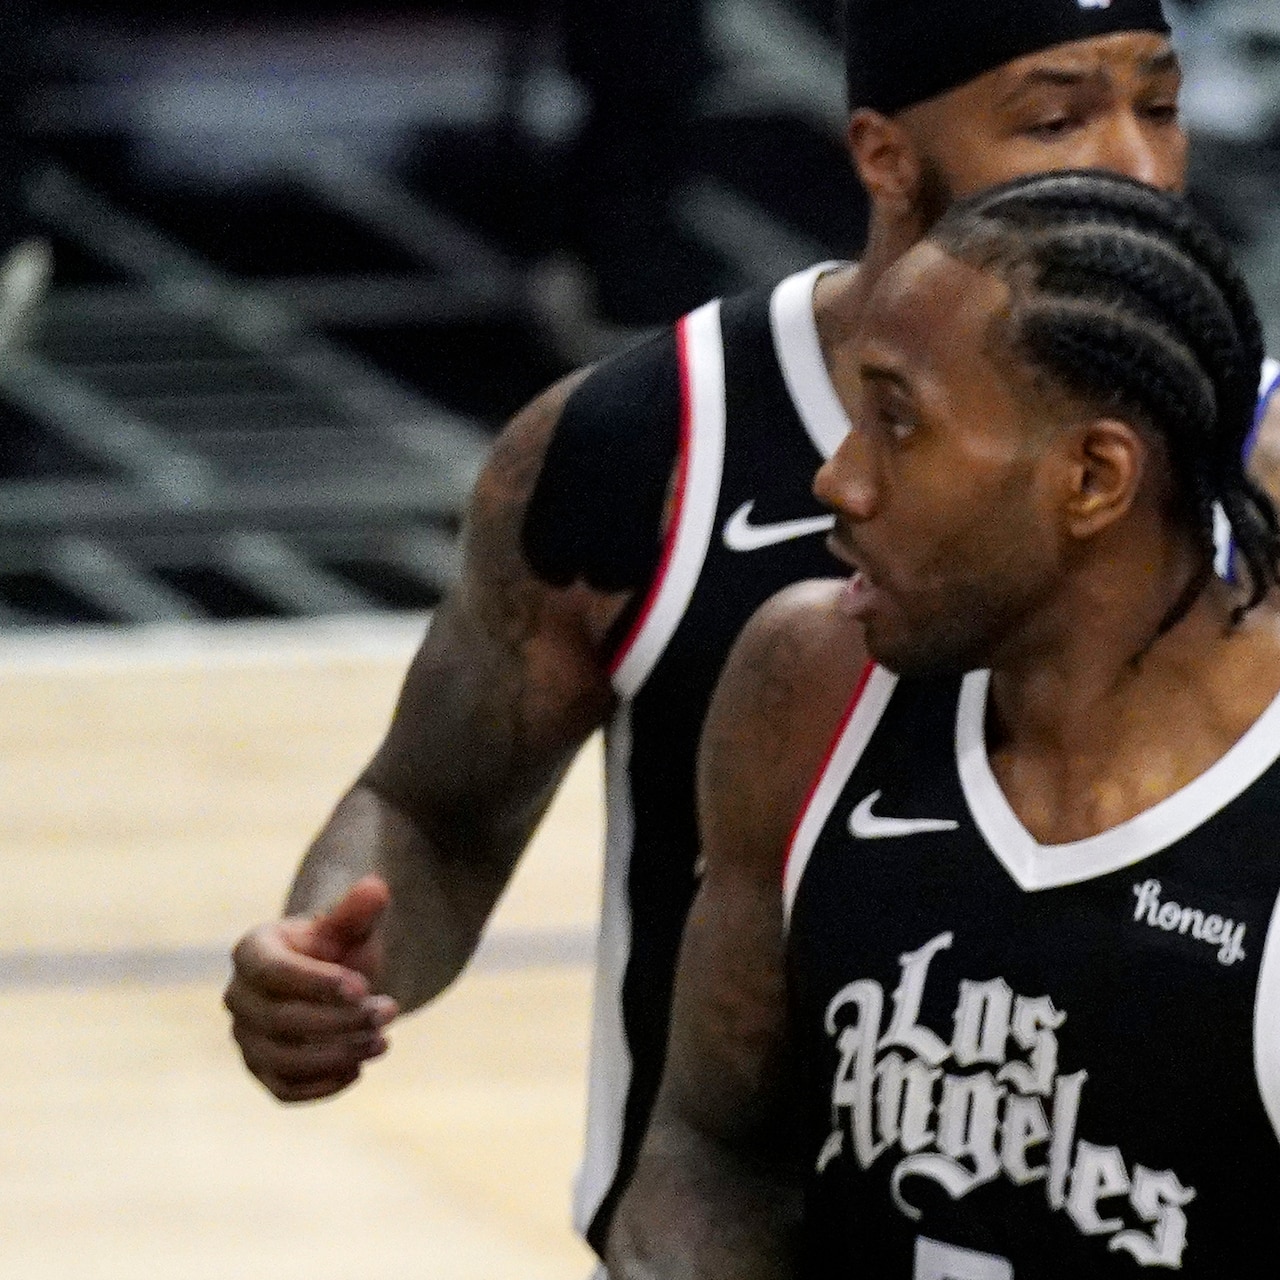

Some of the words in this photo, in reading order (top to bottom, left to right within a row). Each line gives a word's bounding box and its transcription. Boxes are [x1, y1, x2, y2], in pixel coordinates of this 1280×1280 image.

[1132, 878, 1246, 965] honey
[877, 929, 1068, 1098] Los
[815, 977, 1197, 1268] Angeles
